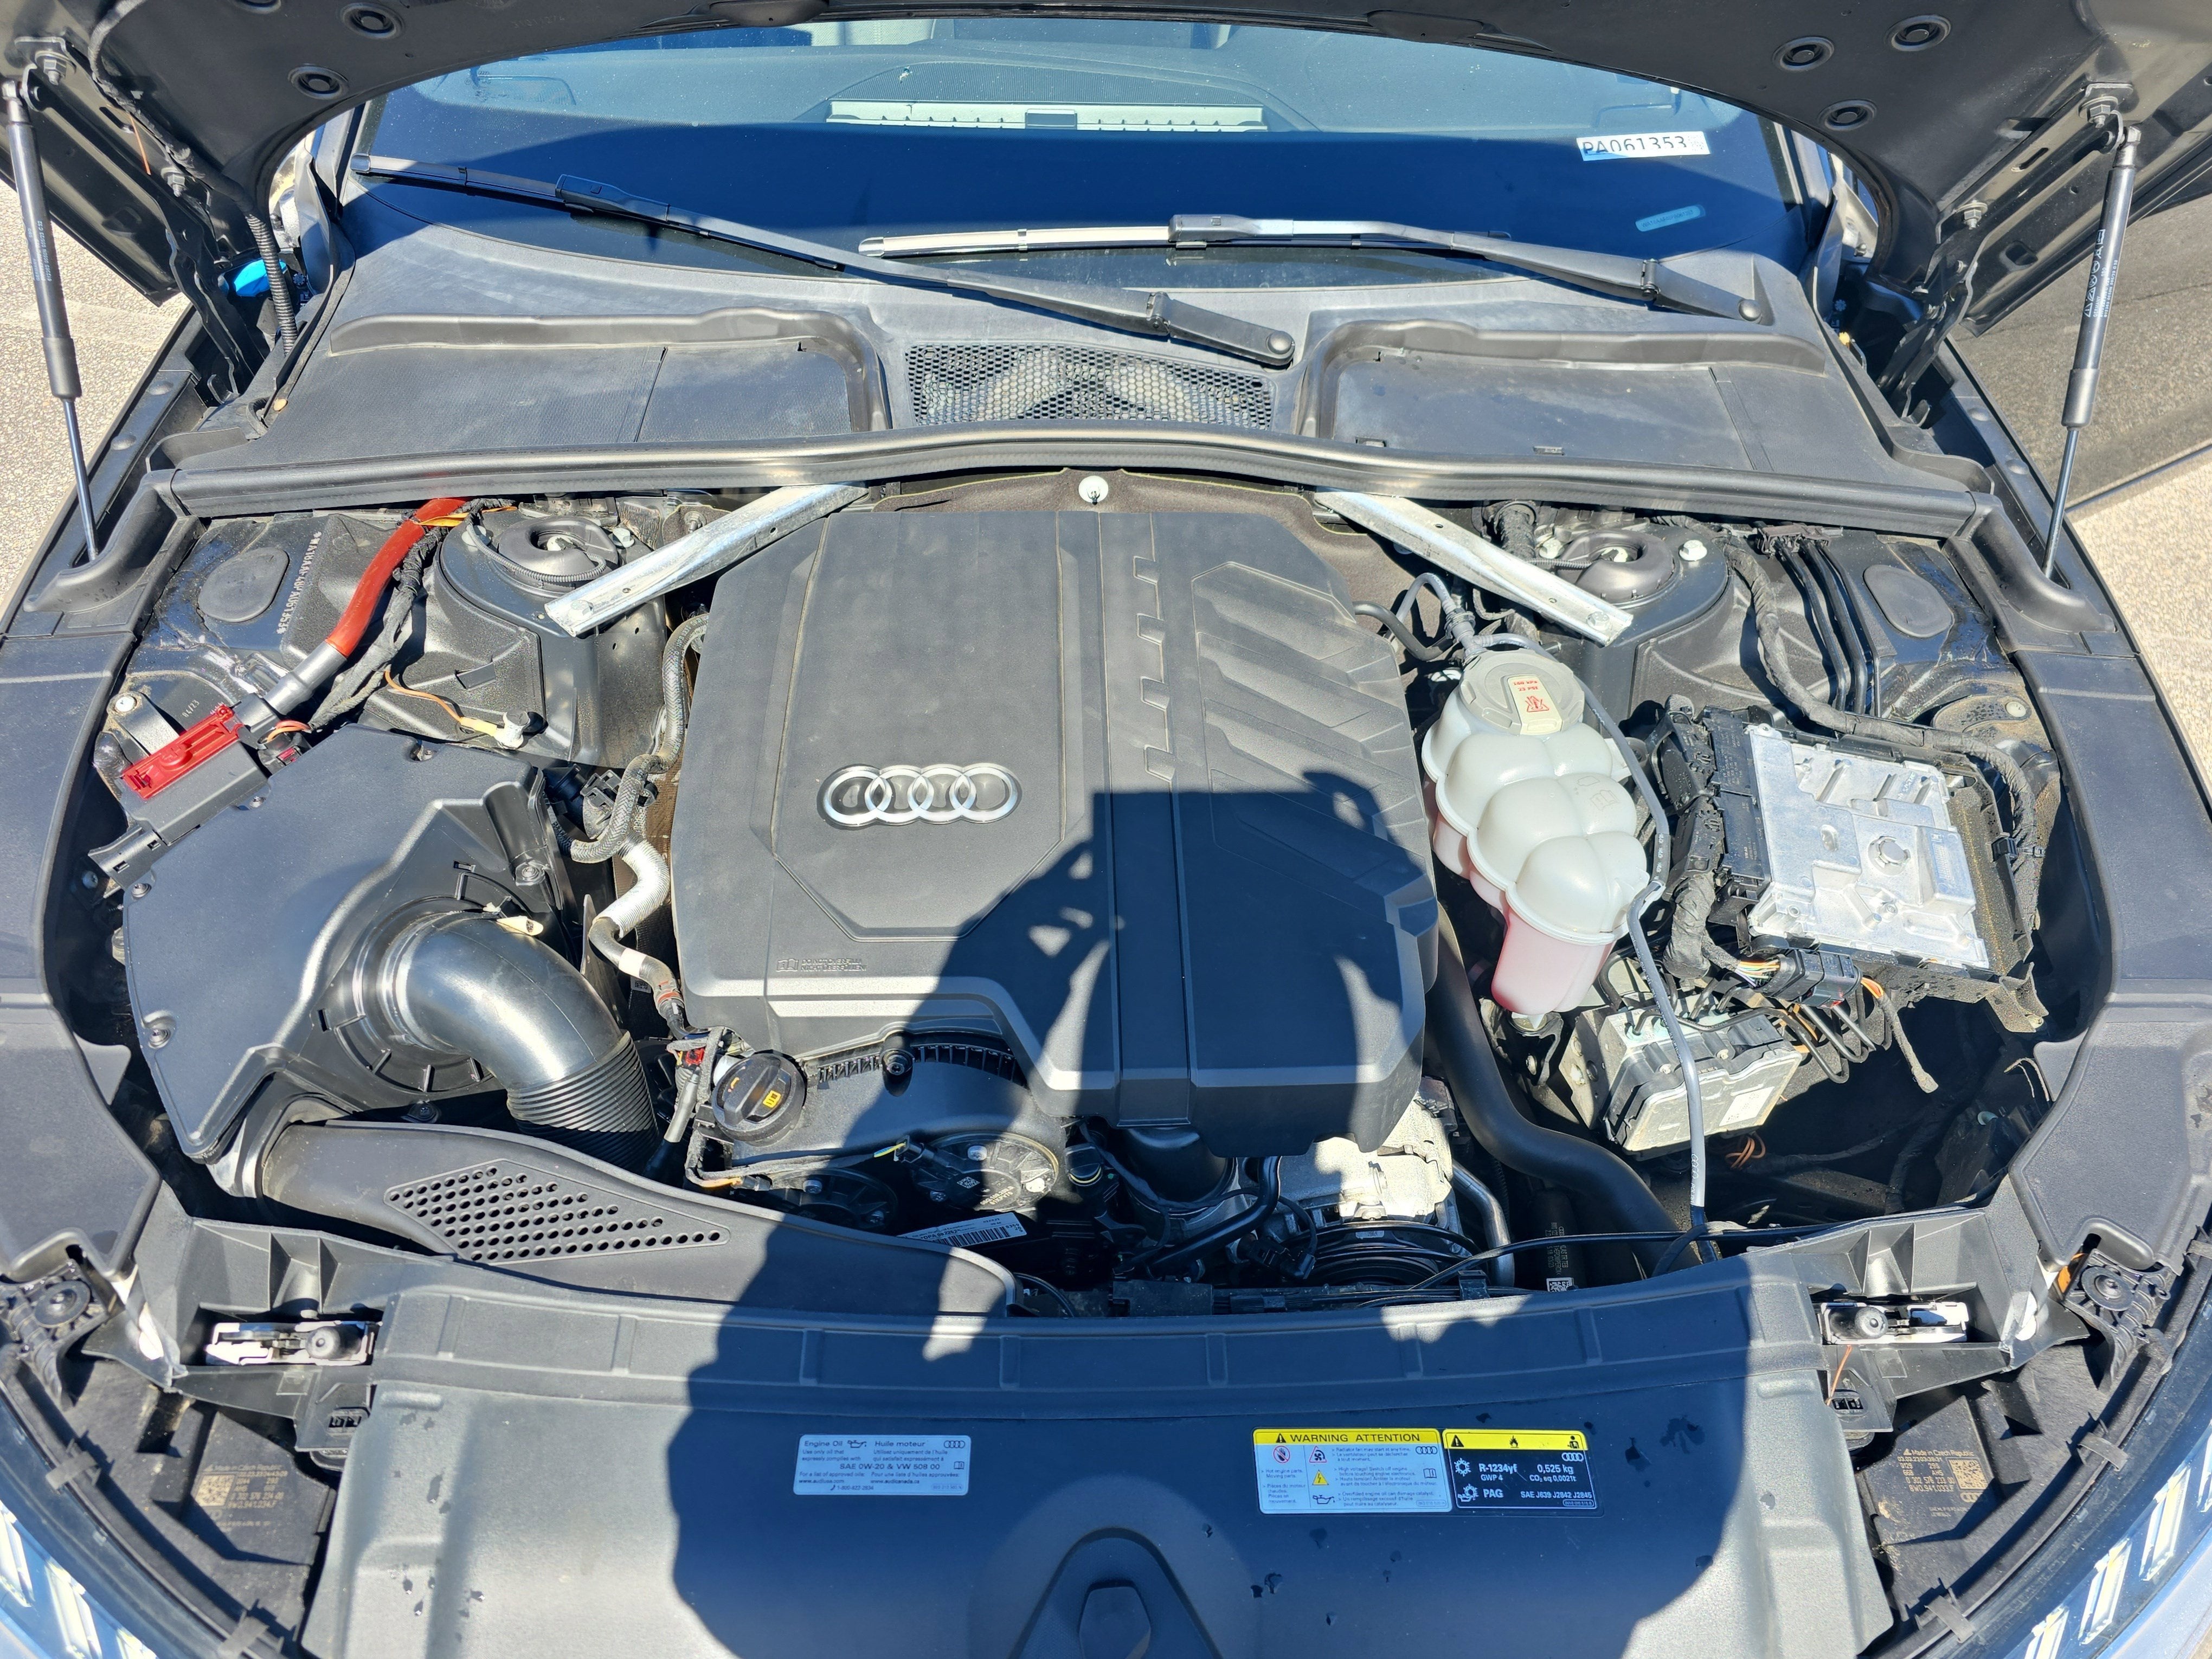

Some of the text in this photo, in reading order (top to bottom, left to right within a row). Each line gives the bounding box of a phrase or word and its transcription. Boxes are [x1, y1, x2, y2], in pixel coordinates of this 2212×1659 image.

[1583, 136, 1687, 155] PA061353
[2093, 296, 2101, 318] GERMANY
[1290, 1433, 1420, 1442] WARNING ATTENTION
[1478, 1463, 1517, 1474] R-1234yf
[1537, 1464, 1574, 1475] 0,525 kg
[1483, 1489, 1504, 1498] PAG
